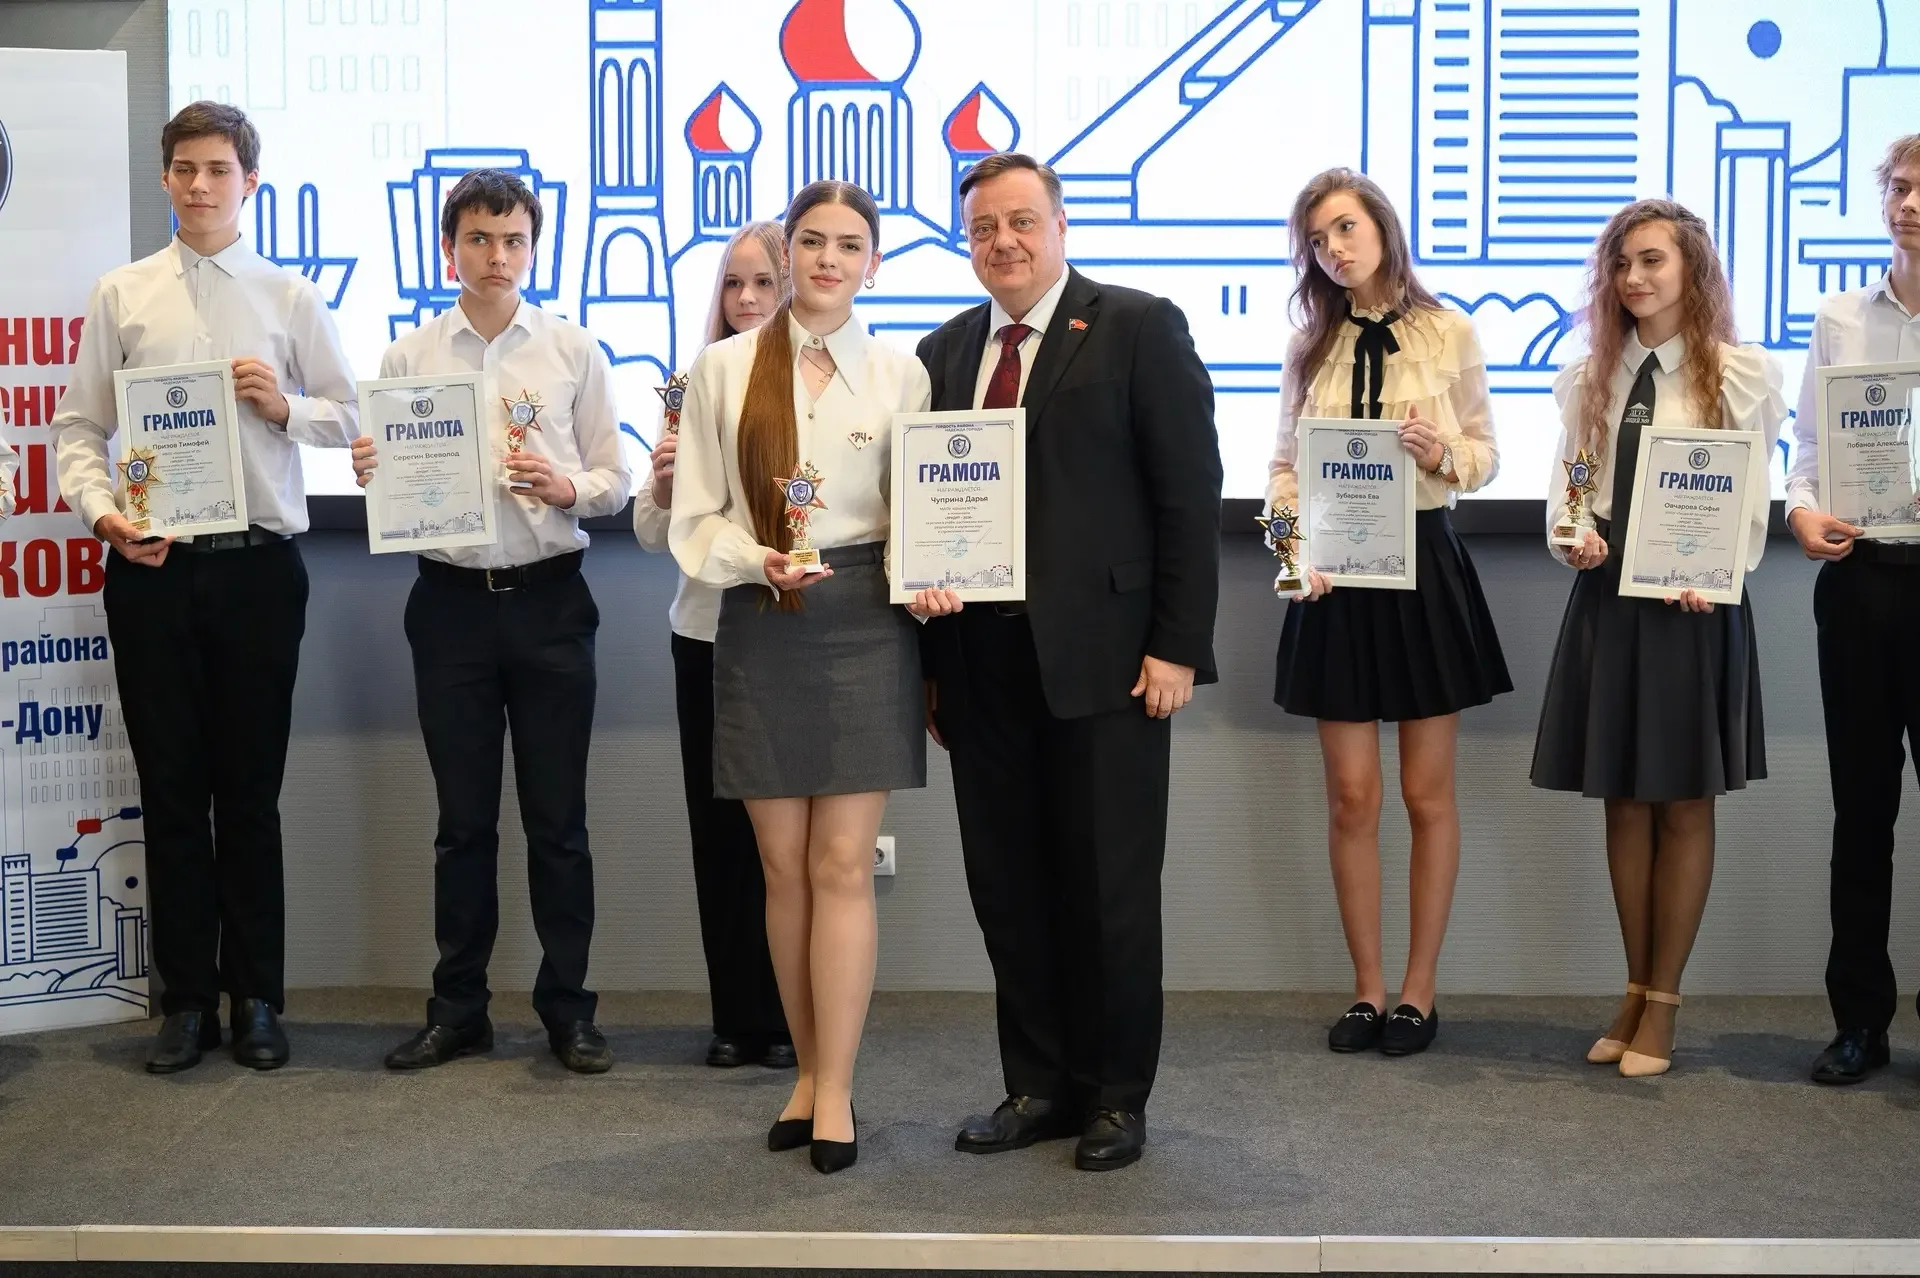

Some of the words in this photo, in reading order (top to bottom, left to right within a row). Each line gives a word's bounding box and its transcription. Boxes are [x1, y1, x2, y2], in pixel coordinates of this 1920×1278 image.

[142, 409, 217, 432] ГРАМОТА
[385, 419, 464, 442] ГРАМОТА
[152, 443, 178, 451] Призов
[179, 440, 210, 449] Тимофей
[1847, 441, 1876, 449] Лобанов
[393, 454, 424, 462] Серегин
[425, 451, 460, 459] Всеволод
[918, 462, 1001, 483] ГРАМОТА
[1322, 462, 1394, 481] ГРАМОТА
[1659, 471, 1733, 493] ГРАМОТА
[930, 496, 964, 504] Чуприна
[964, 495, 989, 503] Дарья
[1336, 492, 1367, 500] Зубарева
[1664, 502, 1698, 511] Овчарова
[1698, 504, 1720, 512] Софья
[2, 633, 108, 672] района
[2, 701, 103, 744] -Дону
